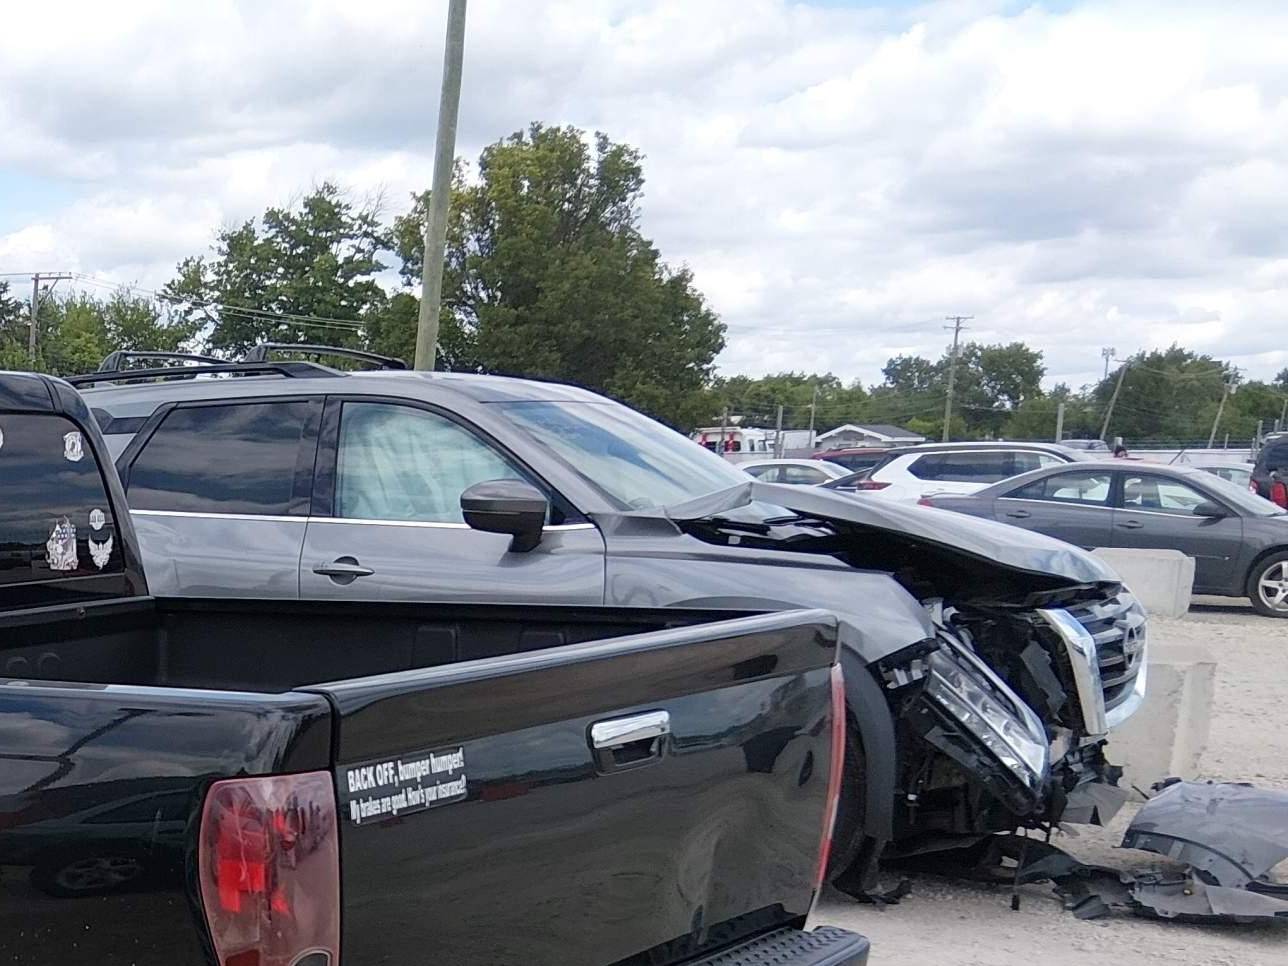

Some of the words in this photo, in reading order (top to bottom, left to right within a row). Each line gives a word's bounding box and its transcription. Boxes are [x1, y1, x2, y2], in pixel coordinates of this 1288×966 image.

[347, 765, 377, 793] BACK
[375, 761, 399, 787] OFF,
[397, 759, 430, 783] bumper
[429, 747, 465, 775] humper!
[349, 799, 361, 825] My
[359, 796, 382, 818] brakes
[381, 796, 392, 813] are
[406, 784, 425, 807] How's
[424, 785, 438, 808] your
